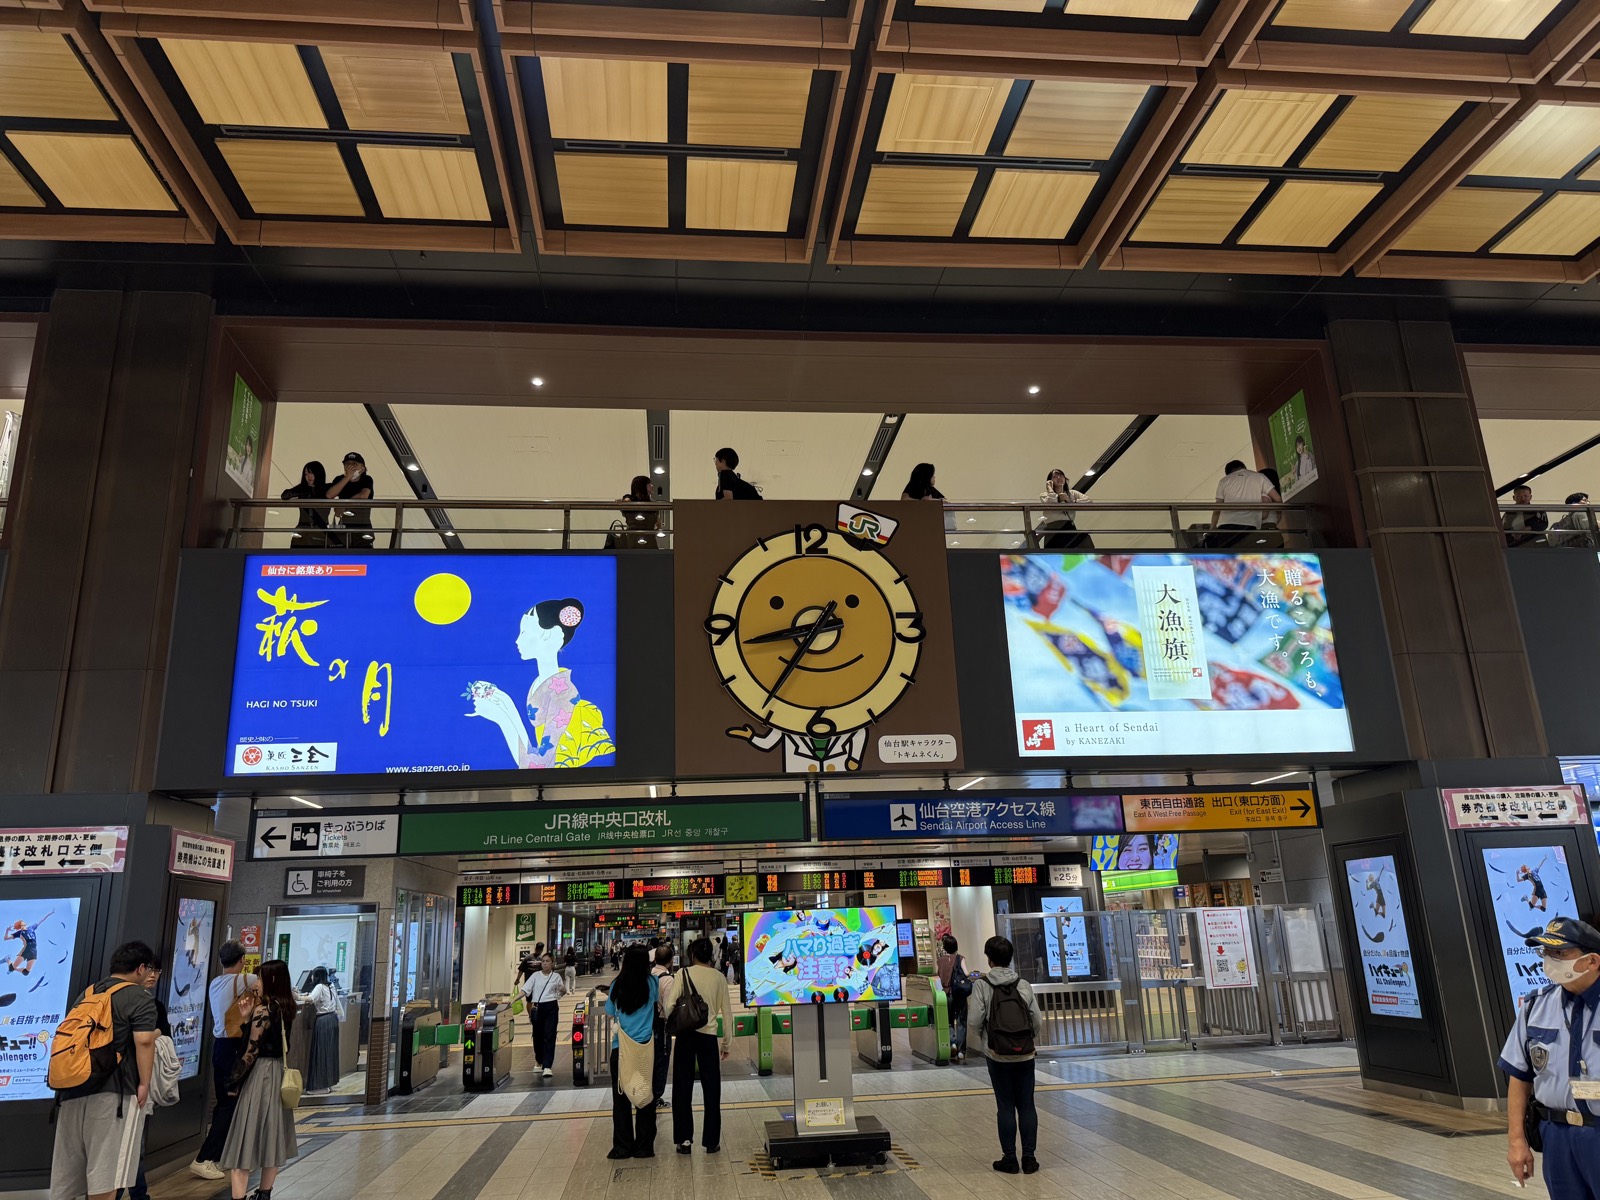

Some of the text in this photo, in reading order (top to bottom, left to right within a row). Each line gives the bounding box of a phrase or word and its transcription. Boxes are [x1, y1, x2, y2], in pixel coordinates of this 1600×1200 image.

[848, 517, 880, 540] JR
[795, 523, 828, 554] 12
[267, 565, 333, 575] 仙台に銘菓あり
[1257, 568, 1288, 658] 大漁です。
[894, 611, 926, 643] 3
[1155, 583, 1189, 662] 大漁旗
[703, 613, 738, 646] 9
[1283, 568, 1323, 697] 贈るこころも、
[246, 699, 318, 708] HAGI NO TSUKI
[806, 706, 837, 738] 6
[1075, 723, 1105, 732] Heart
[1109, 722, 1119, 732] of
[1123, 722, 1159, 732] Sendai
[884, 739, 951, 747] 仙台駅キャラクター
[1078, 737, 1125, 745] KANEZAKI
[919, 800, 1056, 819] 仙台空港アクセス線
[1140, 797, 1205, 810] 東西自由通路
[1133, 810, 1147, 818] East
[1183, 810, 1206, 818] Passage
[1229, 806, 1287, 816] Exit (for East Exit)
[323, 820, 387, 832] きっぷうりば
[545, 810, 672, 830] JR線中央口改札
[920, 819, 1046, 832] Sendai Airport Access Line
[483, 832, 591, 845] JR Line Central Gate
[316, 879, 353, 887] ご利用の方
[782, 934, 860, 956] ハマり過ぎ
